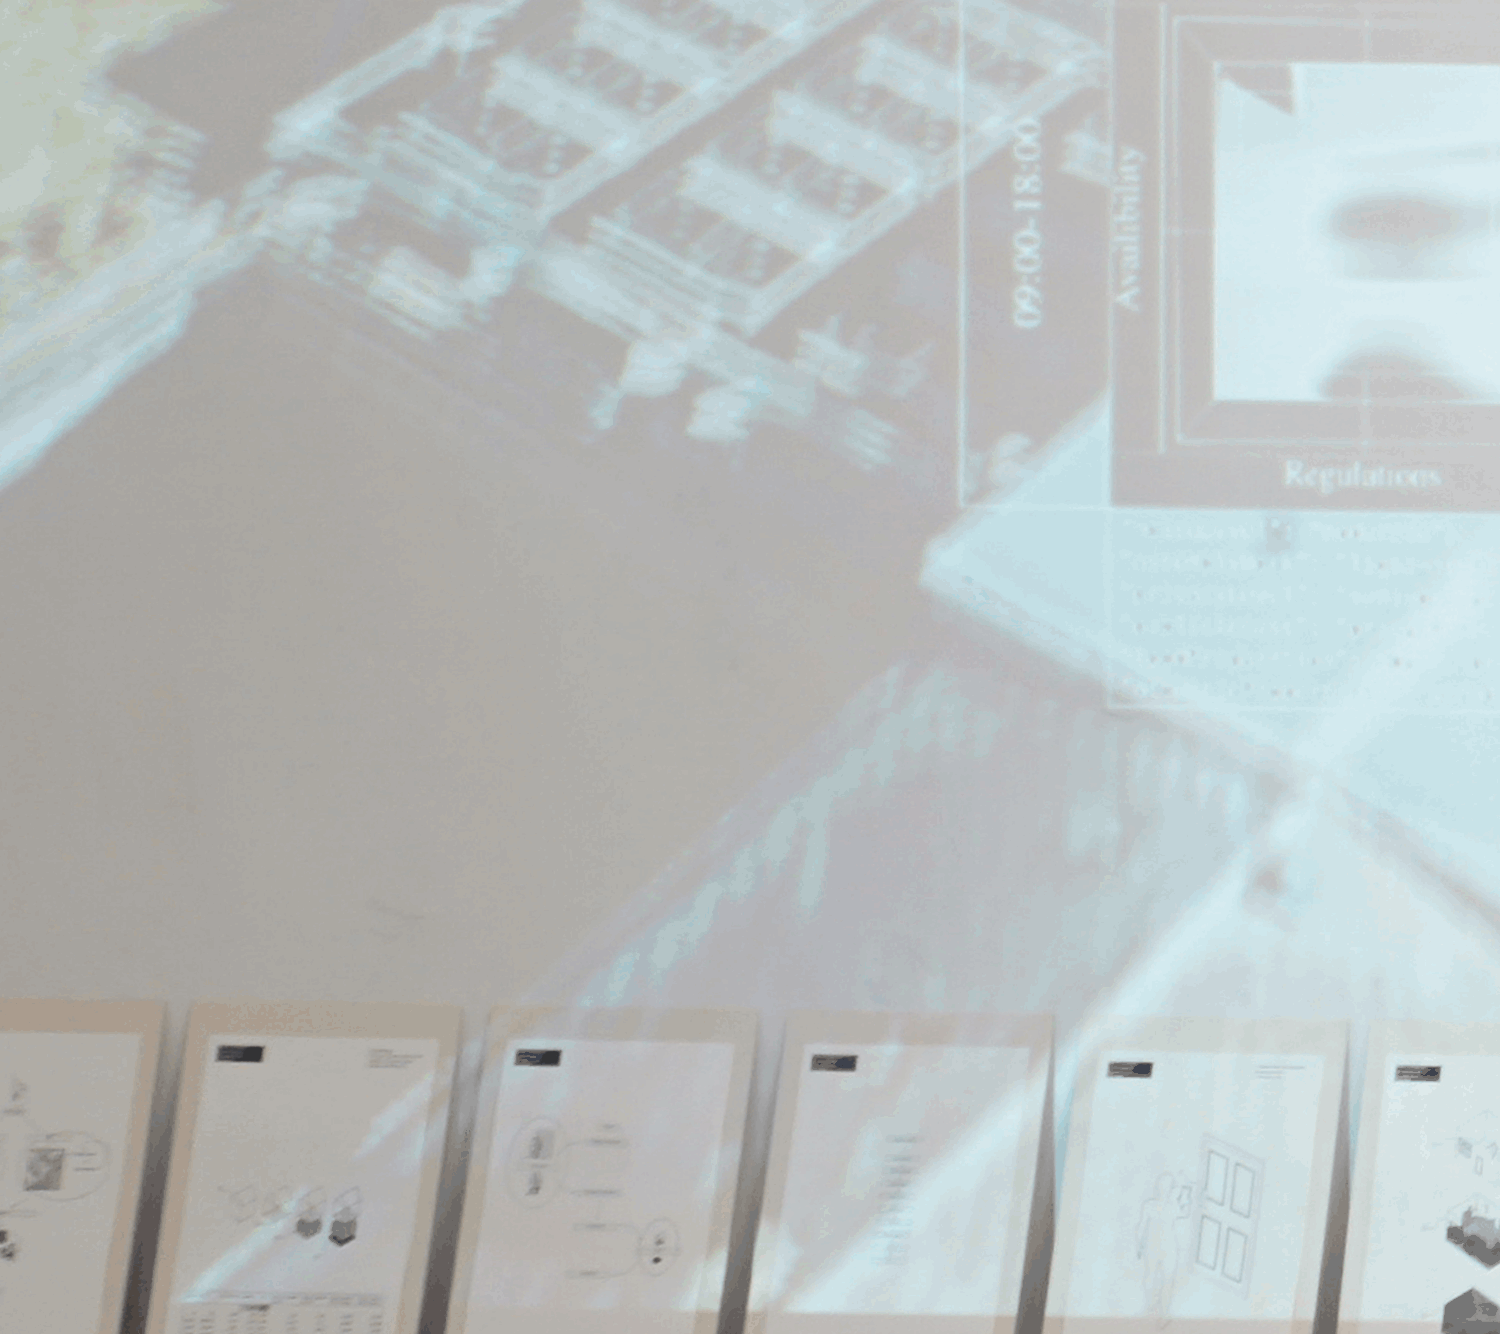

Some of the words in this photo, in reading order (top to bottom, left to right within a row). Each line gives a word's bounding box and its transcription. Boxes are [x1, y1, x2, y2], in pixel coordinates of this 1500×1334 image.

[1014, 117, 1043, 329] 09:00-18:00
[1113, 145, 1147, 312] Availability
[1284, 459, 1443, 495] Regulations
